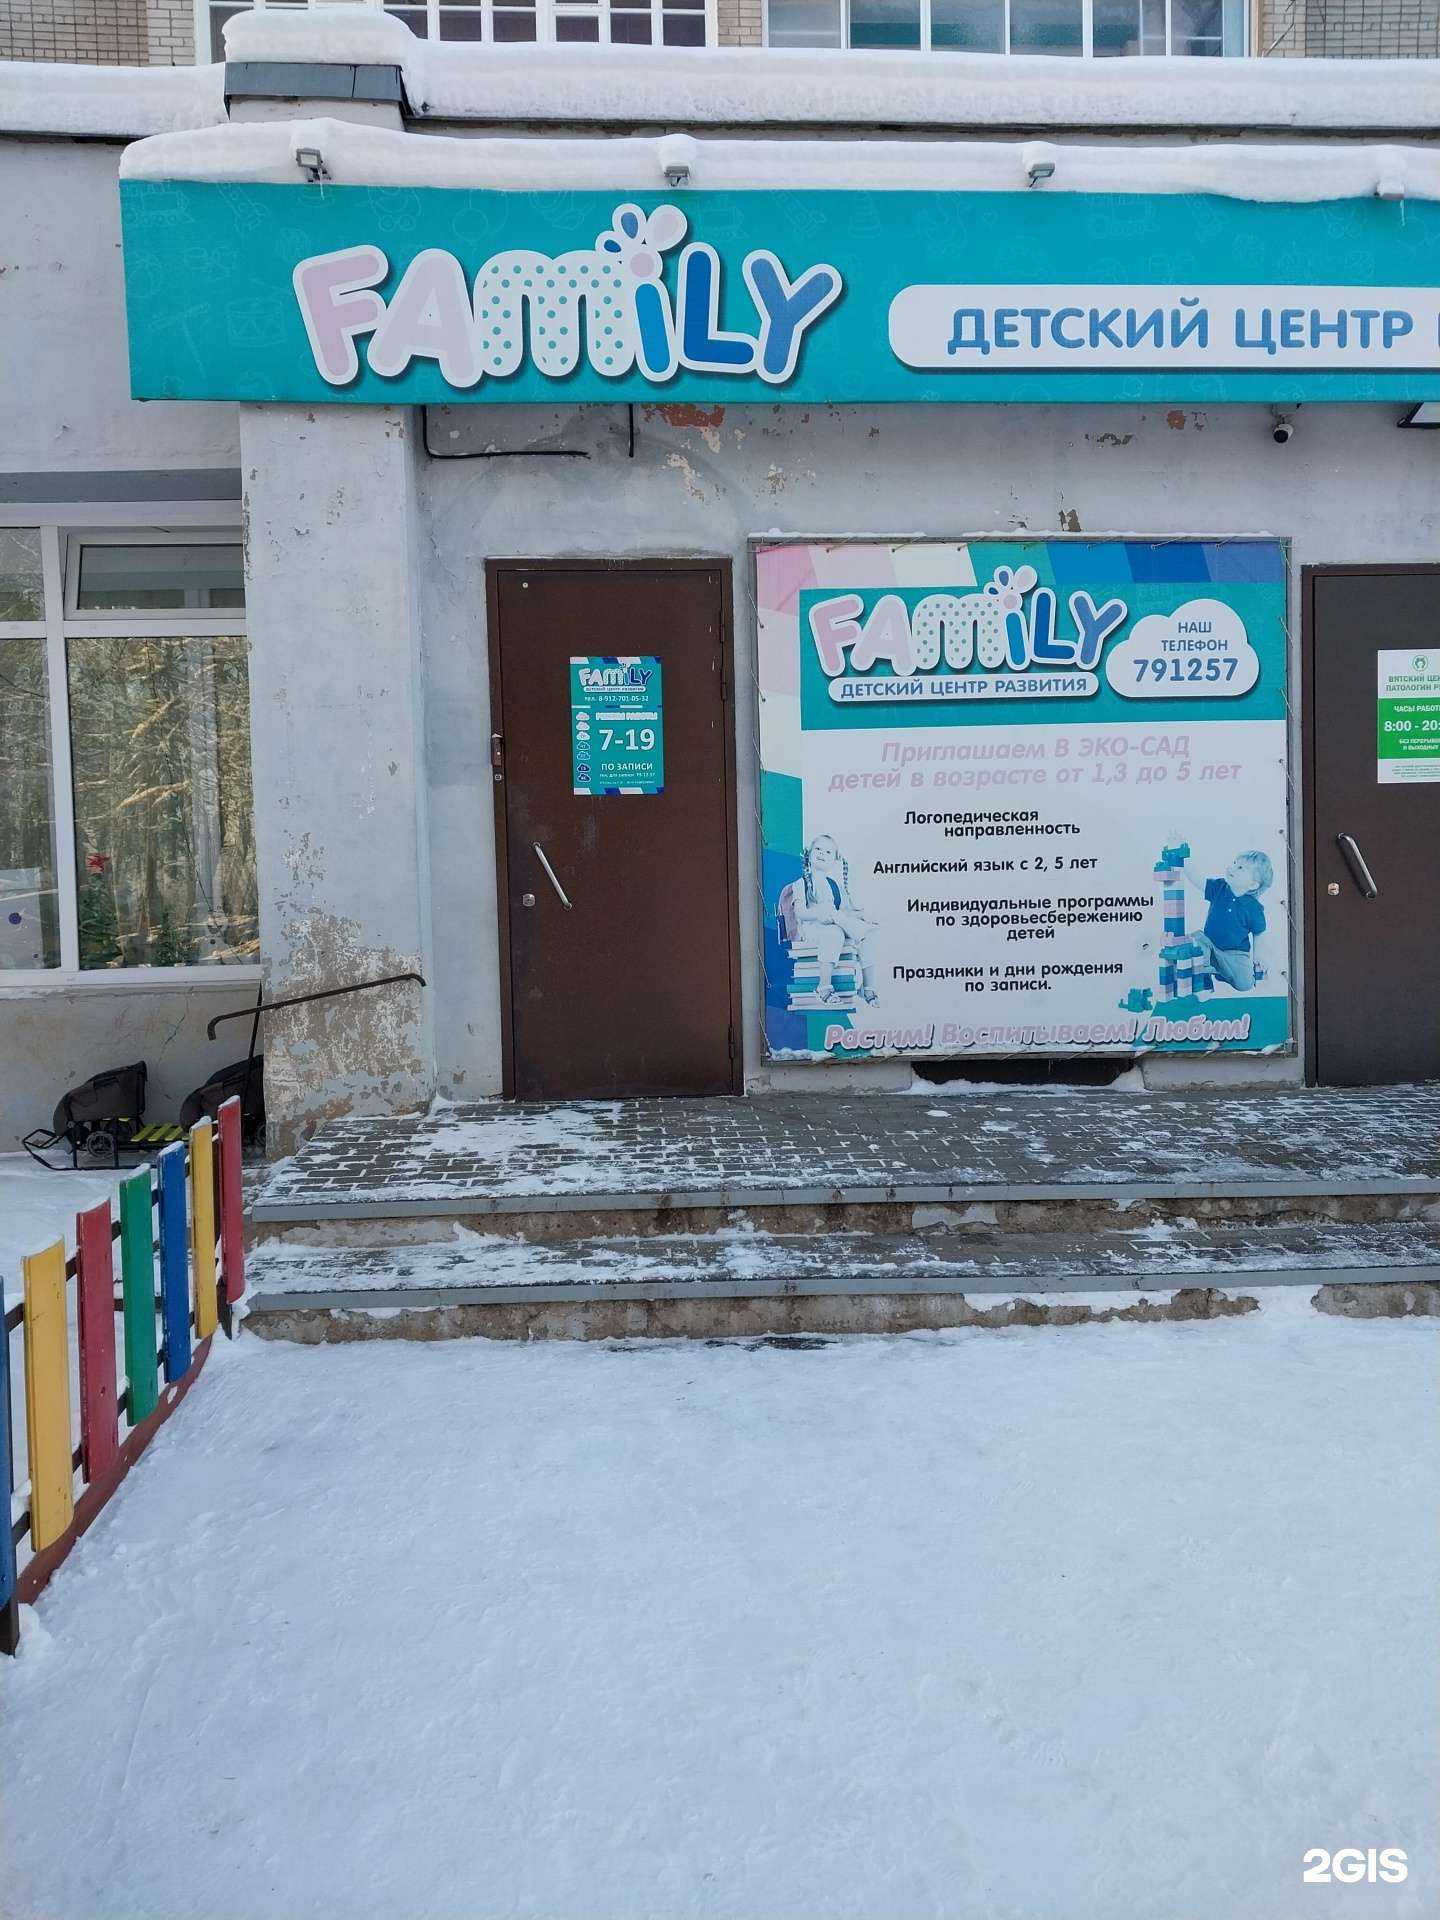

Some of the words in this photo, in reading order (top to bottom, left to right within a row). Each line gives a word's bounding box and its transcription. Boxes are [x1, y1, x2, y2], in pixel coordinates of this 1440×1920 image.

[947, 296, 1208, 355] ДЕТСКИЙ
[1235, 308, 1413, 355] ЦЕНТР
[1178, 621, 1212, 633] НАШ
[1161, 639, 1228, 652] ТЕЛЕФОН
[1133, 657, 1239, 682] 791257
[841, 678, 924, 698] ДЕТСКИЙ
[930, 680, 988, 697] ЦЕНТР
[994, 677, 1087, 694] РАЗВИТИЯ
[1384, 720, 1411, 731] 8:00
[599, 728, 655, 751] 7-19
[881, 742, 1046, 767] Приглашаем
[1054, 738, 1070, 758] В
[1077, 735, 1191, 759] ЭКО-САД
[617, 763, 653, 771] ЗАПИСИ
[828, 768, 902, 793] детей
[910, 772, 924, 788] в
[933, 769, 1047, 791] возрасте
[1056, 768, 1085, 783] от
[1091, 762, 1128, 786] 1,3
[1135, 765, 1169, 785] до
[1175, 760, 1192, 782] 5
[1199, 764, 1243, 781] лет
[904, 809, 1039, 825] Логопедическая
[944, 823, 1081, 840] направленность
[873, 859, 968, 875] Английский
[973, 859, 1014, 872] язык
[1020, 860, 1028, 870] с
[1034, 857, 1048, 872] 2,
[1054, 857, 1064, 869] 5
[1069, 857, 1098, 870] лет
[907, 898, 1051, 914] Индивидуальные
[1057, 895, 1154, 910] программы
[935, 915, 956, 927] по
[961, 909, 1143, 927] здоровьесбережению
[1007, 925, 1055, 941] детей
[893, 965, 983, 980] Праздники
[989, 967, 999, 977] и
[1005, 965, 1035, 978] дни
[1041, 961, 1123, 978] рождения
[965, 980, 984, 992] по
[990, 978, 1052, 991] записи.
[824, 1024, 935, 1050] Растим!
[941, 1018, 1138, 1047] Воспитываем!
[1142, 1013, 1250, 1043] Любим!
